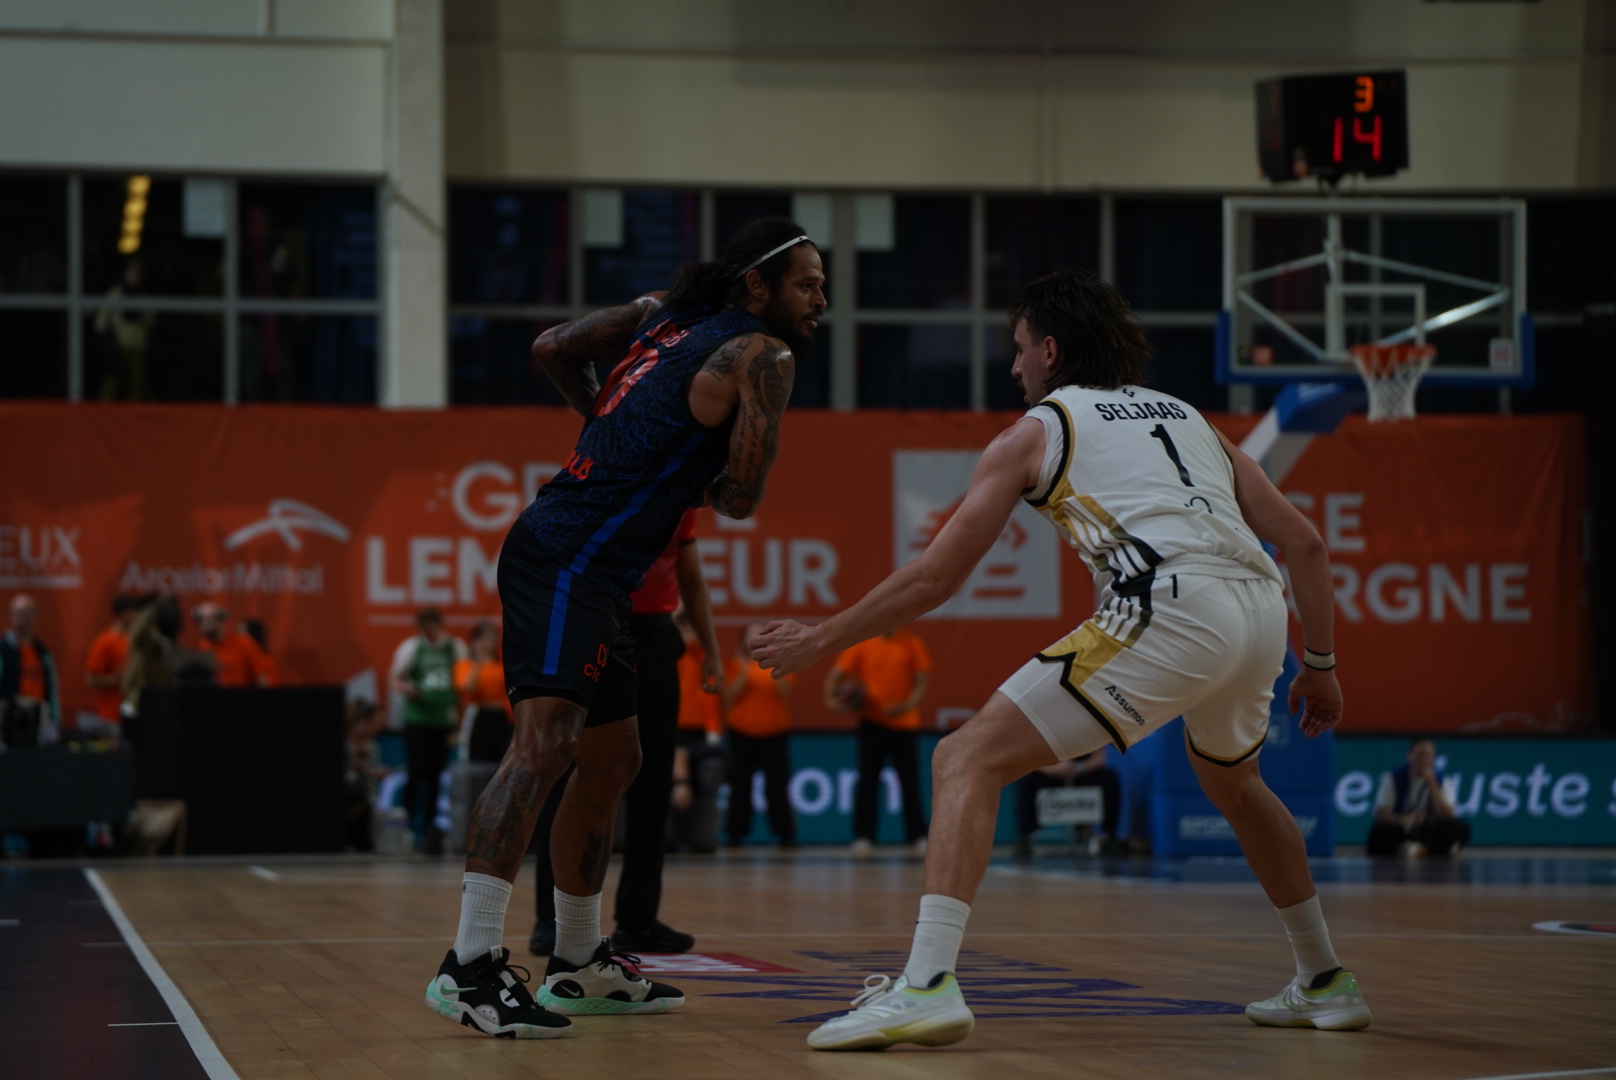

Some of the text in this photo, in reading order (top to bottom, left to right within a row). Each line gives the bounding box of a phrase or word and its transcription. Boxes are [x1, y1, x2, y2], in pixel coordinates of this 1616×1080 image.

[1352, 75, 1376, 114] 3
[1331, 114, 1384, 165] 14
[1094, 401, 1188, 421] SELJAAS
[1149, 423, 1196, 488] 1
[118, 560, 325, 596] ArcelorMittal
